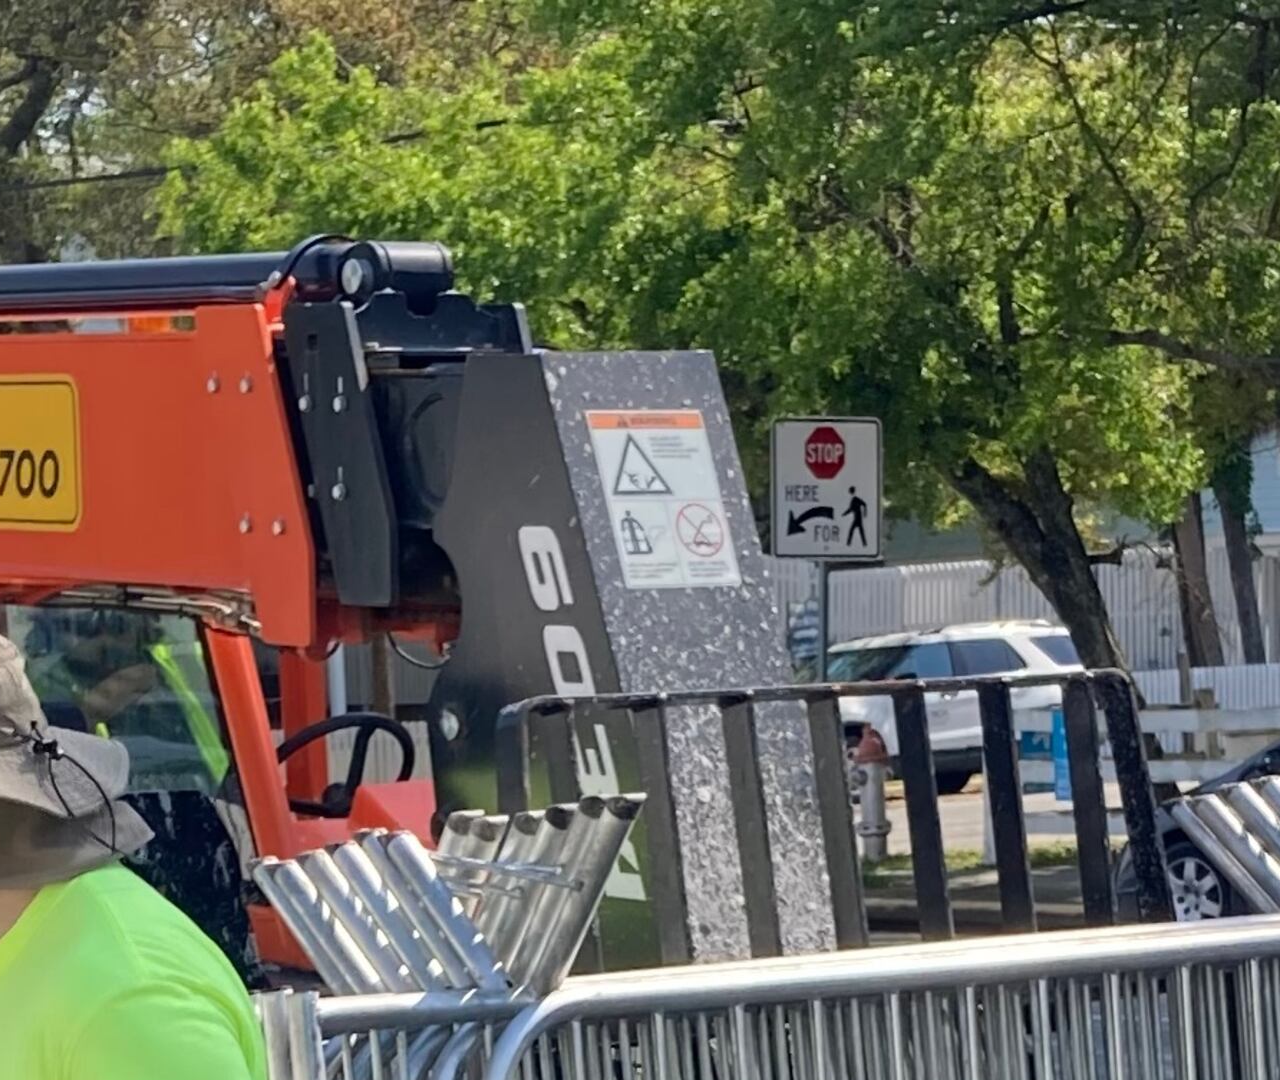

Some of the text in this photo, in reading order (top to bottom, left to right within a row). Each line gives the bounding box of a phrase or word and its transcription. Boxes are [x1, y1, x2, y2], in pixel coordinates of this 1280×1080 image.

[807, 443, 843, 463] STOP
[785, 485, 819, 502] HERE
[814, 525, 840, 542] FOR
